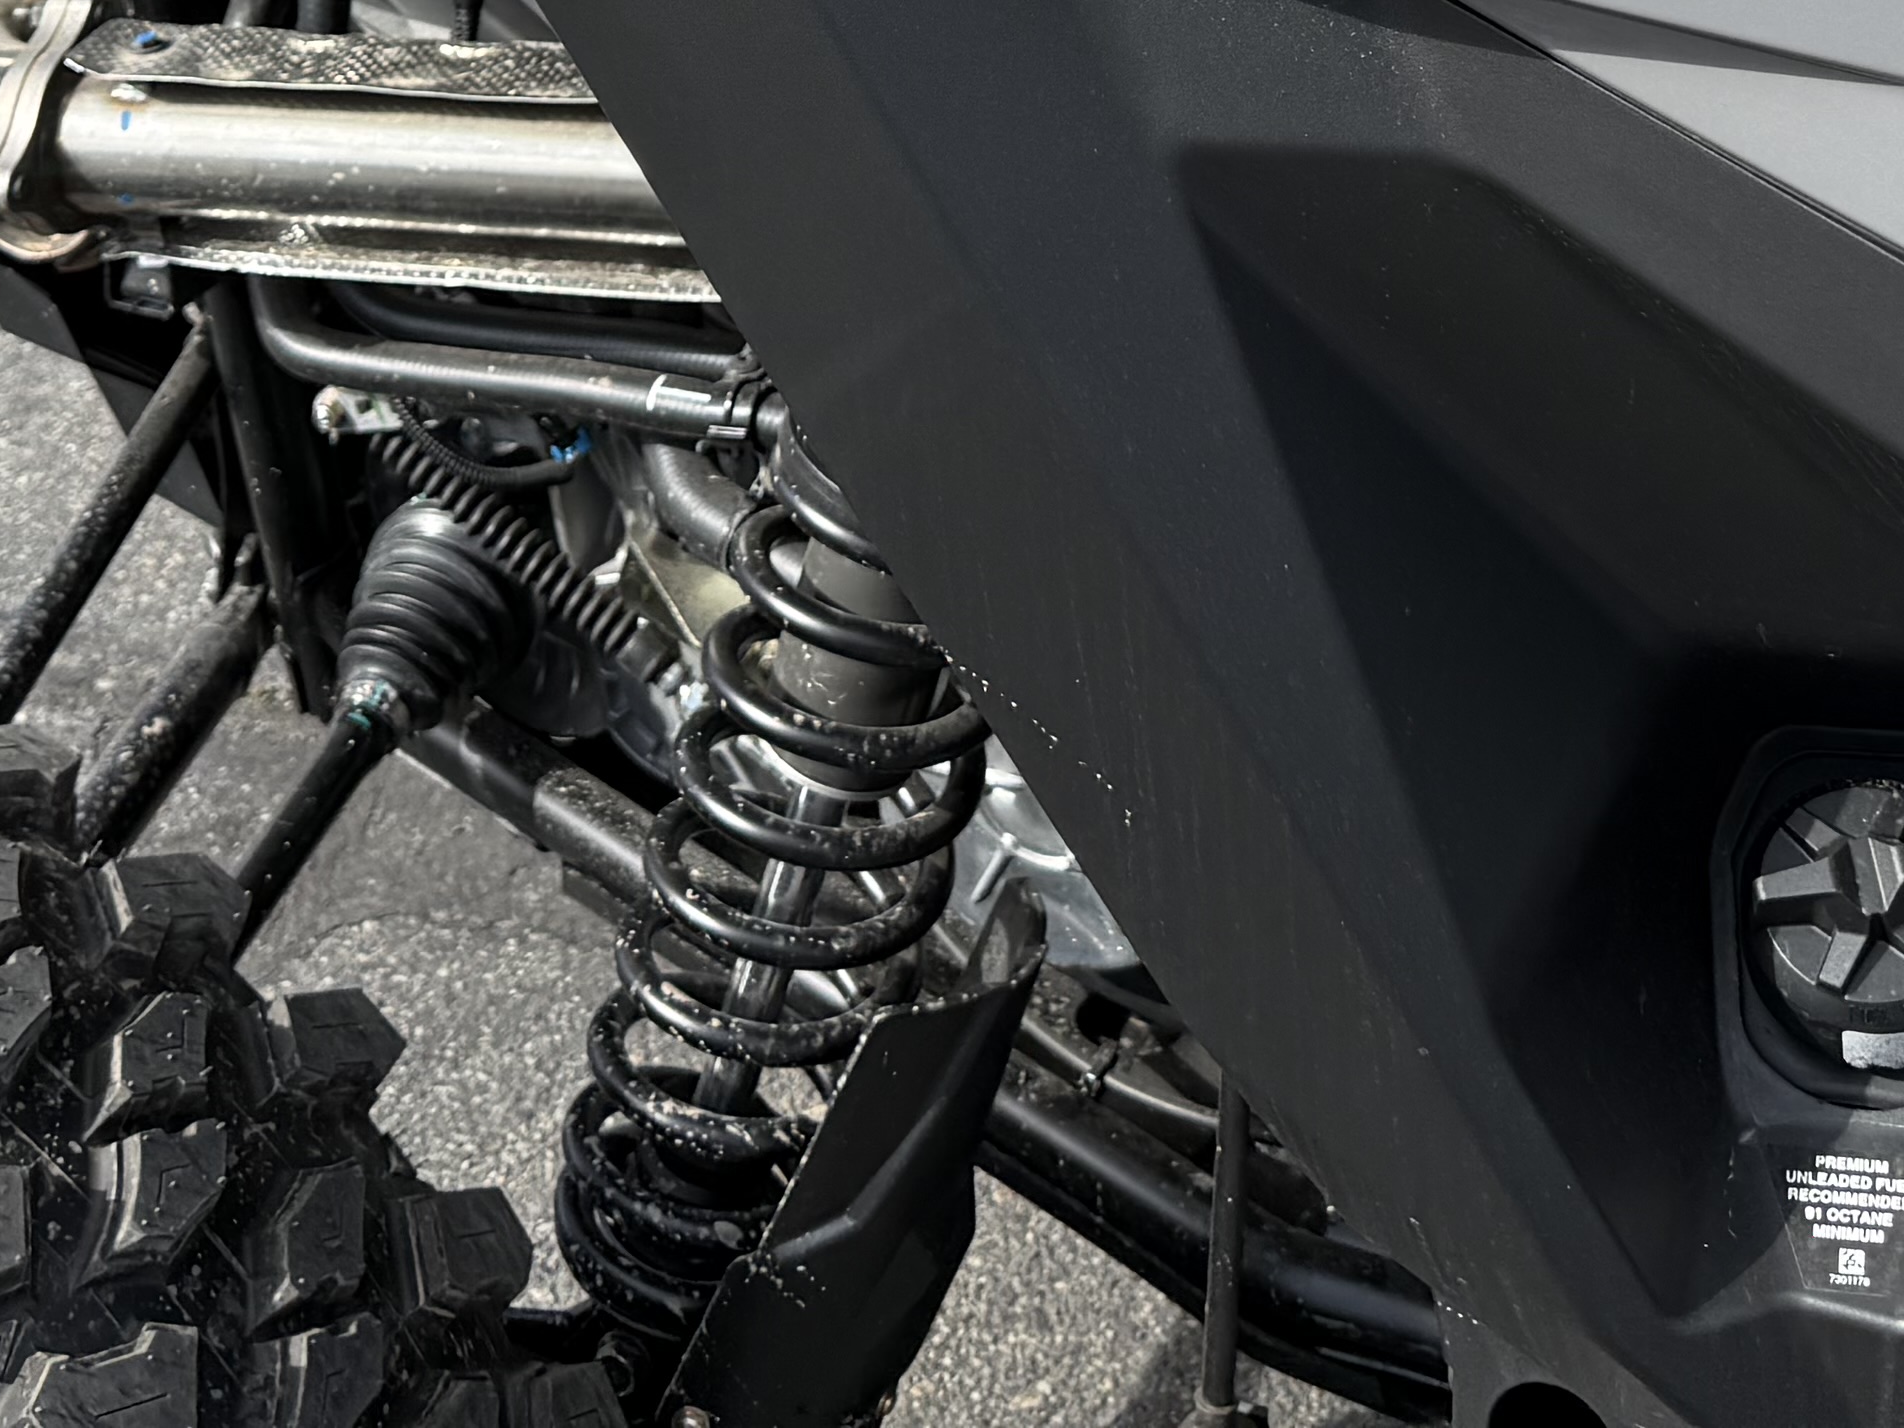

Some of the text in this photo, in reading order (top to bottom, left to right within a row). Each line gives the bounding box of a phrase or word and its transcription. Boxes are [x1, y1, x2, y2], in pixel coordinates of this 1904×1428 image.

[1815, 1155, 1890, 1174] PREMIUM
[1785, 1169, 1873, 1191] UNLEADED
[1804, 1206, 1894, 1227] 91 OCTANE
[1812, 1223, 1885, 1244] MINIMUM
